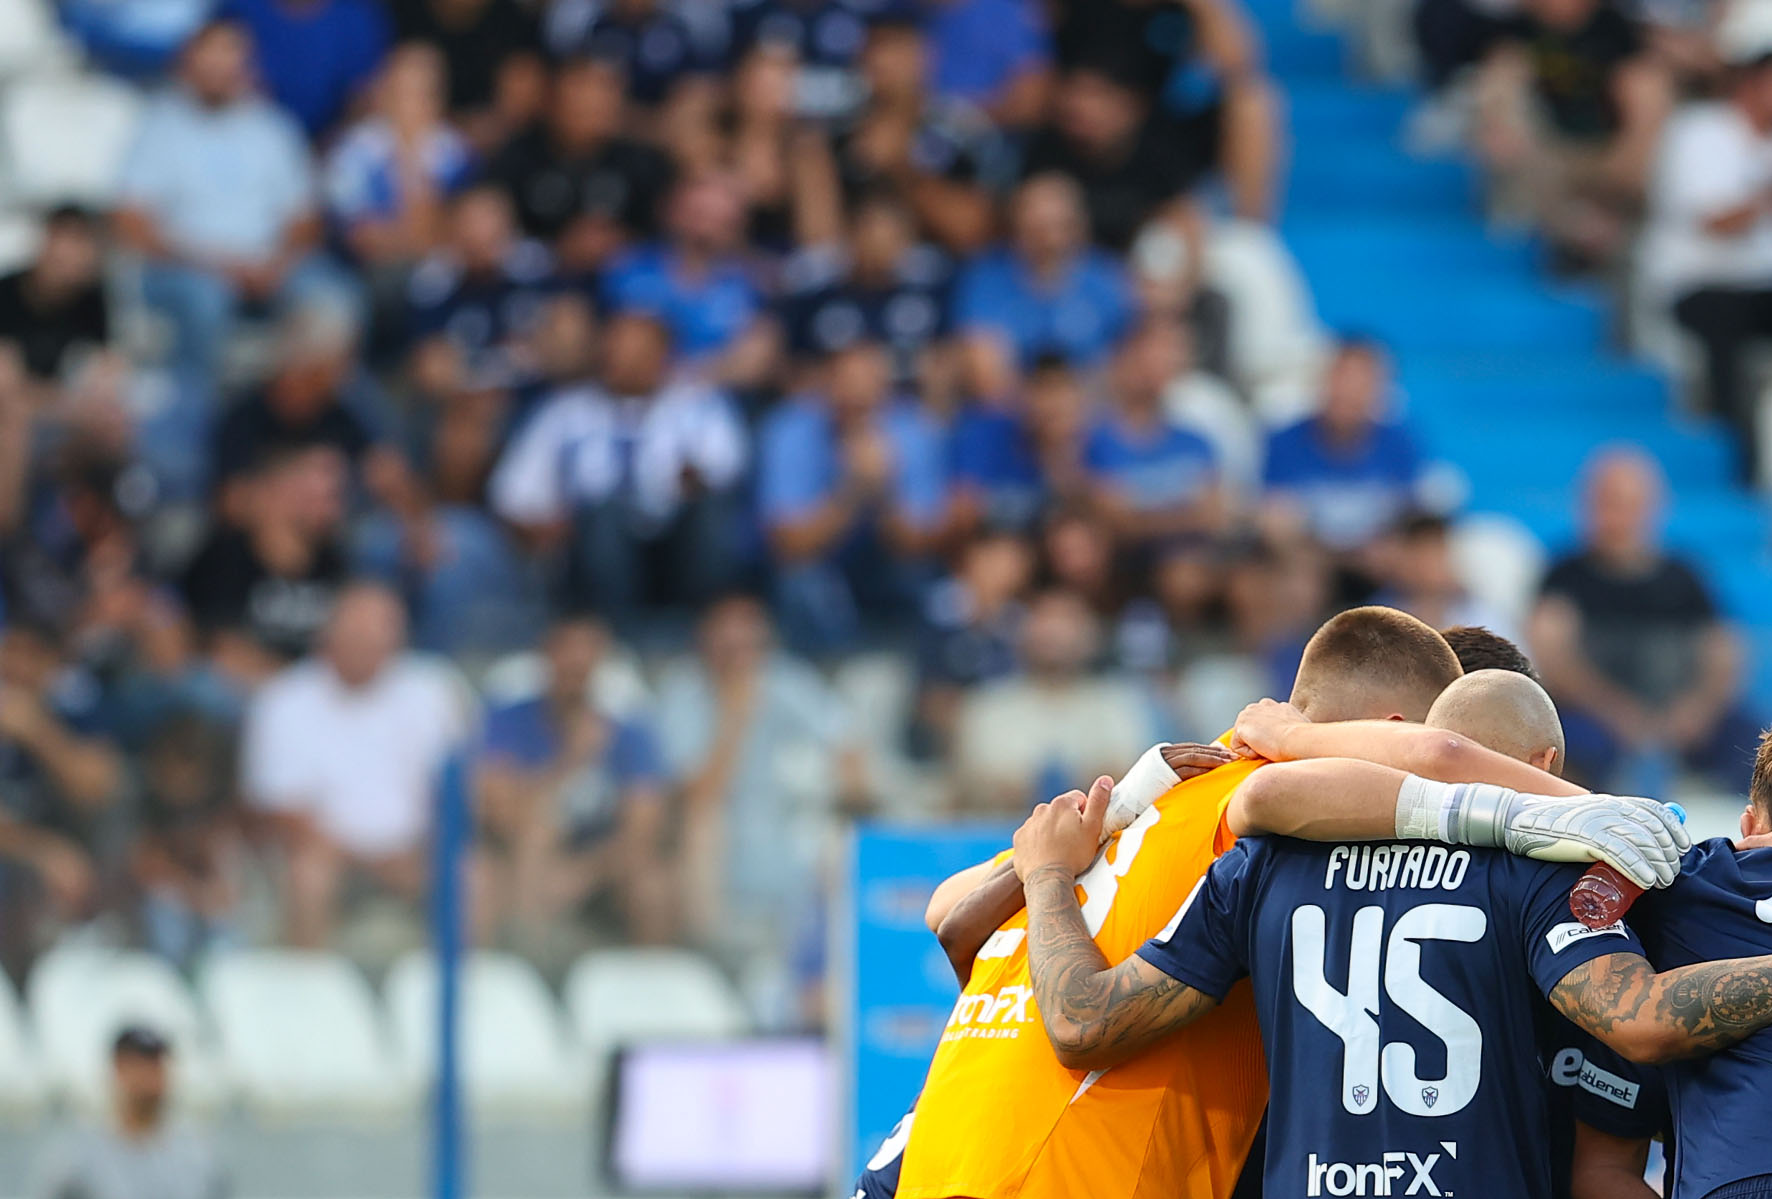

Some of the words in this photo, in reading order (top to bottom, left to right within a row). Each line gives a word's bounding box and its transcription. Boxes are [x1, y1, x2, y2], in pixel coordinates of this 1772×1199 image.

[1324, 845, 1471, 891] FURTADO
[947, 984, 1034, 1027] ronFX
[1292, 903, 1487, 1117] 45
[1581, 1069, 1633, 1103] ablenet
[1307, 1151, 1442, 1197] IronFX
